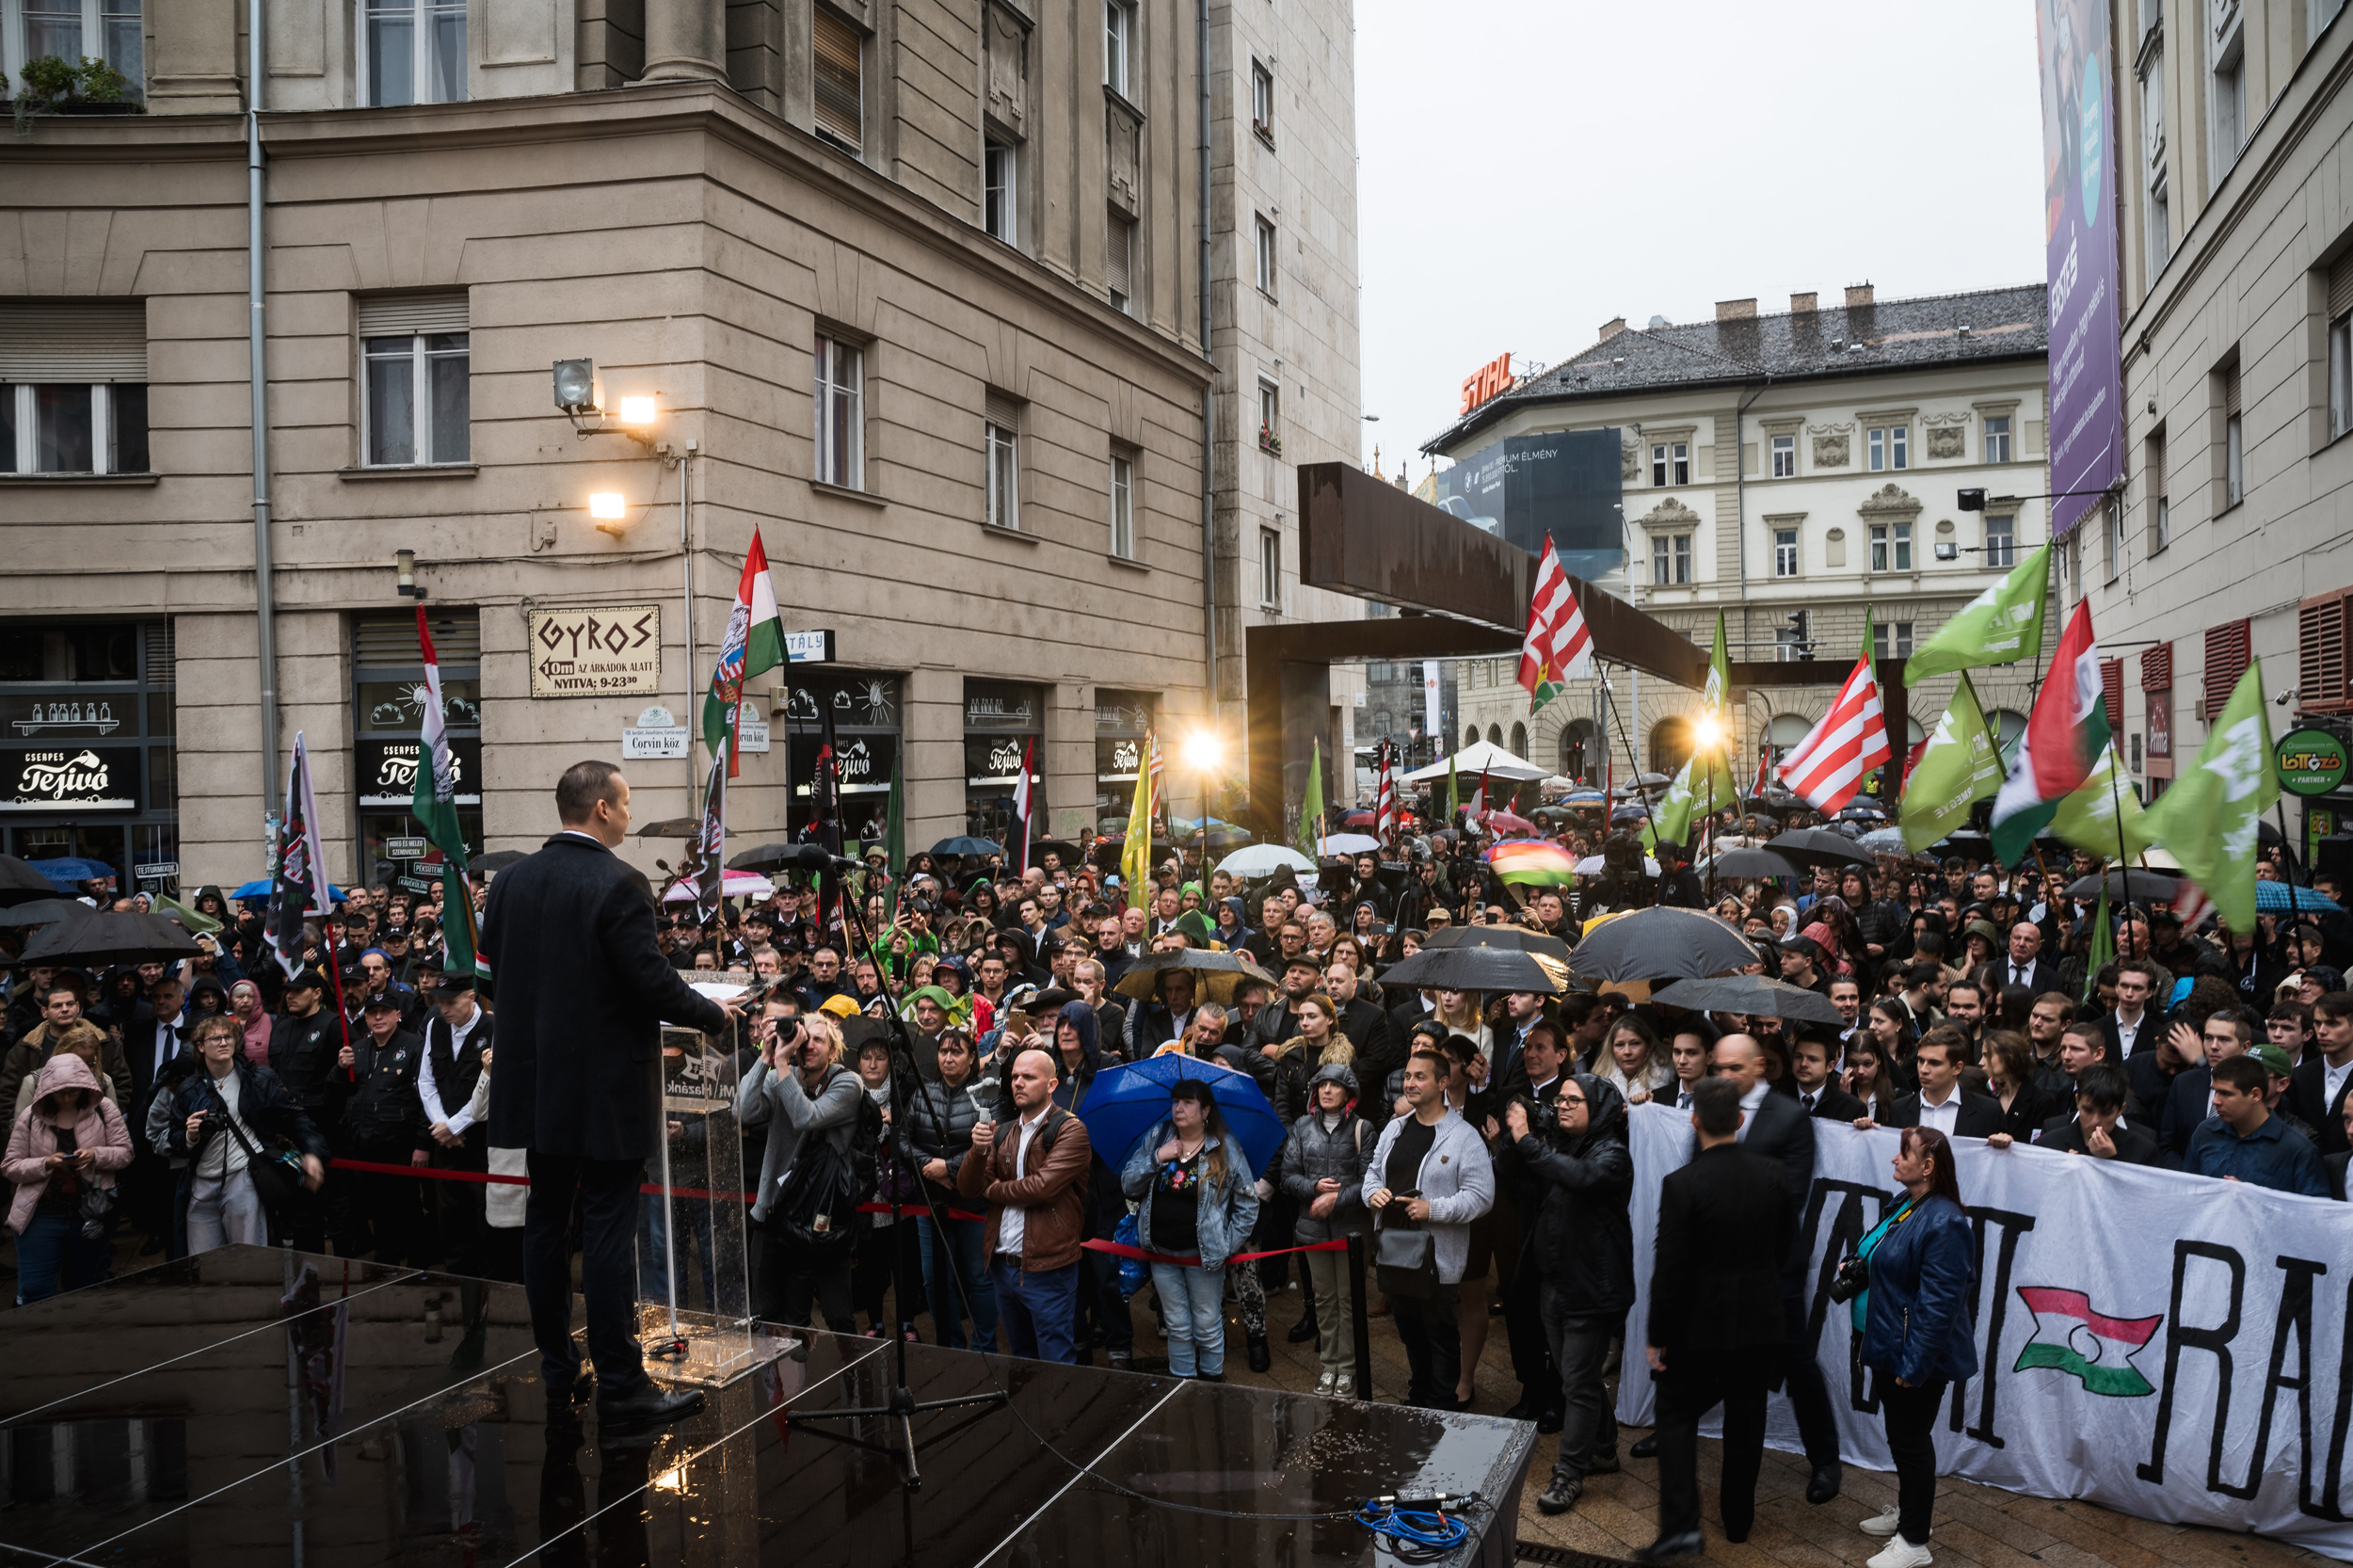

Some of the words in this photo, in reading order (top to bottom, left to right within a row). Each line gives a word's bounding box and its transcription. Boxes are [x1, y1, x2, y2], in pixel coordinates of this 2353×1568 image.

[2052, 255, 2071, 328] ERSTE
[1460, 352, 1514, 415] STIHL
[1521, 448, 1558, 462] ÉLMÉNY
[537, 613, 652, 658] GYROS
[542, 662, 574, 676] 10m
[578, 664, 588, 674] AZ
[590, 661, 628, 673] ÁRKÁDOK
[630, 661, 653, 672] ALATT
[554, 678, 597, 690] NYITVA:
[632, 737, 662, 749] Corvin
[664, 737, 680, 748] köz
[754, 731, 764, 743] köz
[2150, 724, 2169, 754] Prima
[25, 753, 65, 762] CSERPES
[384, 745, 421, 756] CSERPES
[838, 751, 870, 784] ejivó
[988, 747, 1022, 776] Tejivó
[1112, 749, 1139, 774] Tejivó
[18, 757, 109, 800] Tejivó
[2297, 776, 2326, 784] PARTNER
[392, 848, 421, 856] SZENDVICSEK
[136, 864, 177, 875] TEJTURMIXOK
